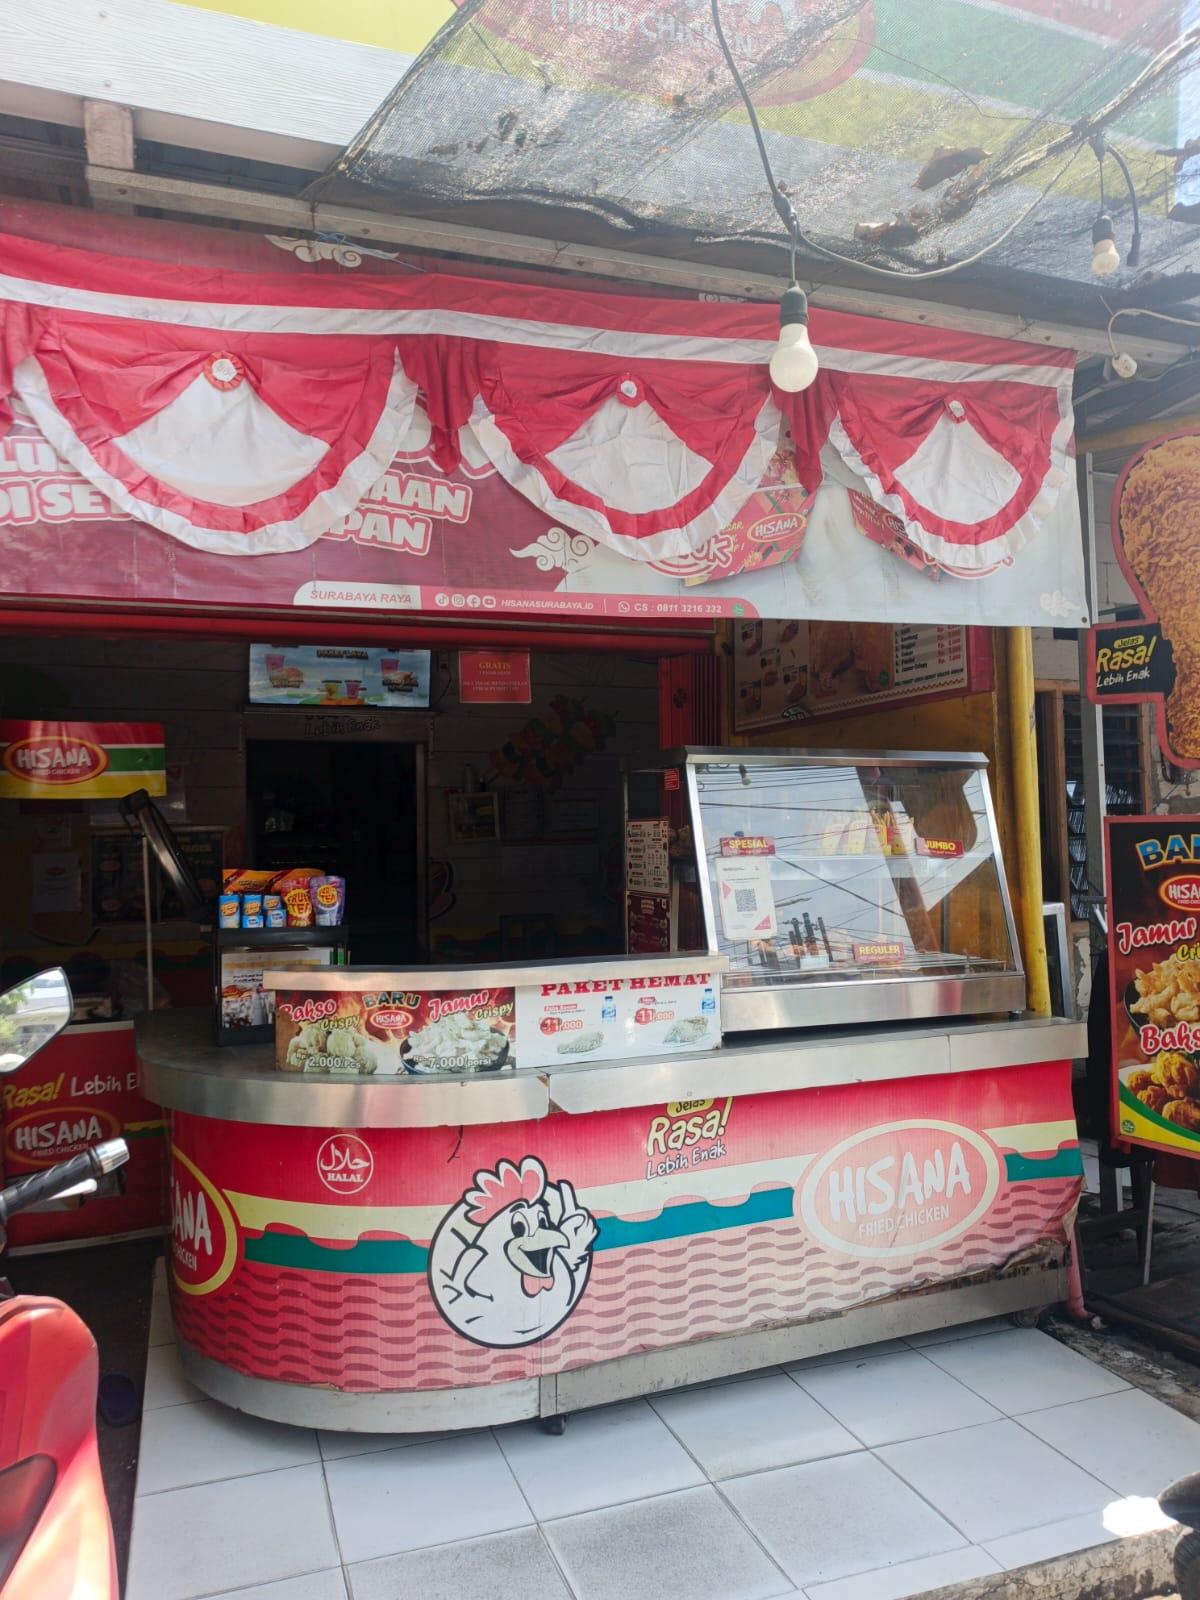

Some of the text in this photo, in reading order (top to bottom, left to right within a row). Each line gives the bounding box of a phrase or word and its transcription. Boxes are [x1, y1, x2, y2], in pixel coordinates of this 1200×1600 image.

[310, 589, 412, 604] SURABAYA RAYA
[656, 603, 679, 613] 0811
[705, 605, 722, 614] 332
[1096, 636, 1157, 673] Rasa!
[1096, 666, 1151, 688] Lebih Enak
[16, 746, 93, 769] HISANA
[728, 838, 769, 849] SPESIAL
[924, 839, 956, 851] JUMBO
[1117, 917, 1197, 954] Jamur
[859, 945, 900, 956] REGULER
[541, 972, 711, 997] PAKET HEMAT
[362, 990, 421, 1010] BARU
[427, 989, 490, 1023] Jamur
[474, 1002, 514, 1021] Crispy
[320, 1015, 361, 1031] Crispy
[70, 1074, 122, 1097] Lebih
[15, 1115, 102, 1150] HISANA
[646, 1096, 734, 1157] Rasa!
[320, 1143, 370, 1171] حلال
[646, 1140, 727, 1181] Lebih Enak
[327, 1172, 364, 1183] HALAL
[828, 1141, 971, 1224] HISANA
[858, 1204, 950, 1239] FRIED CHICKEN
